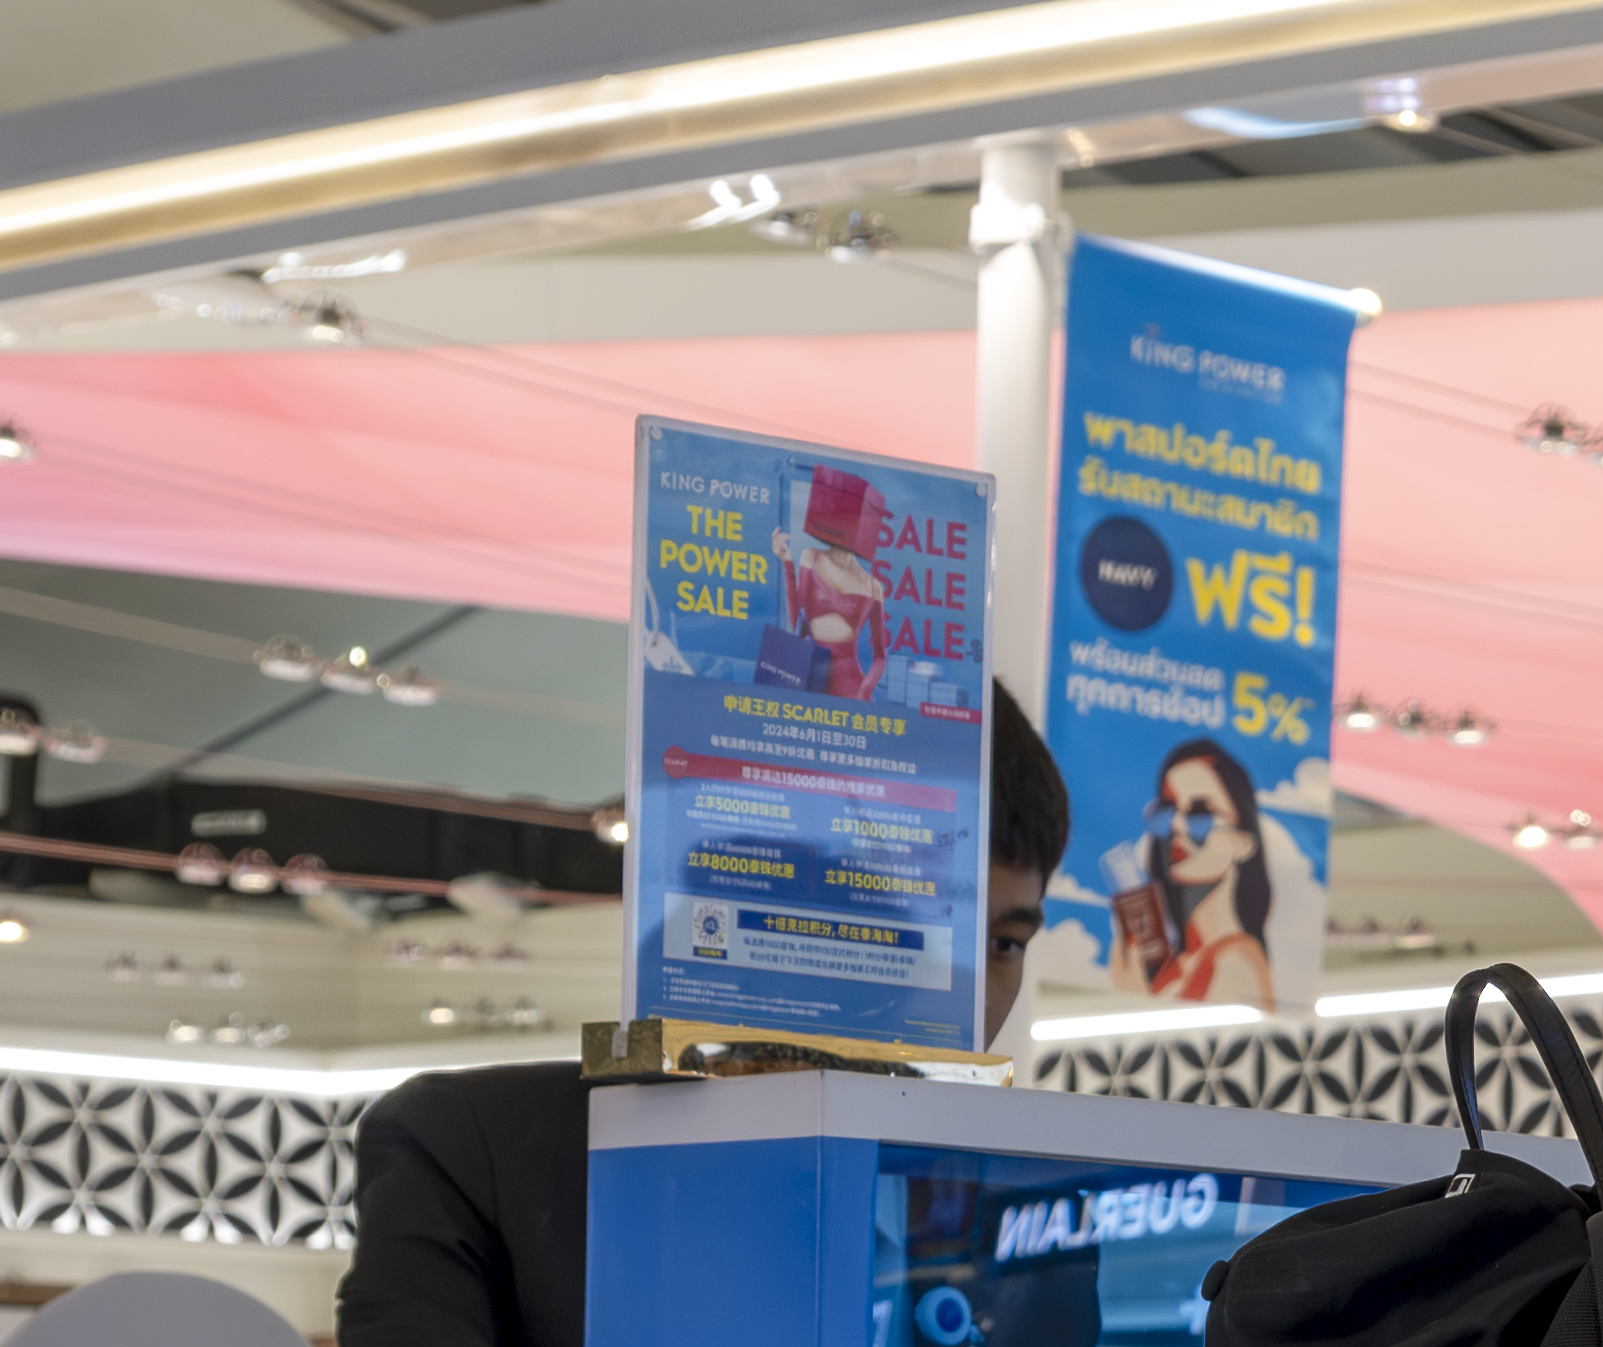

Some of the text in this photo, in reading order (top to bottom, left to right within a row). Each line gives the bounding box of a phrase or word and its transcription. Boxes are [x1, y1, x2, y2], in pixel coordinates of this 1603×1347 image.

[1130, 335, 1287, 392] KING POWER
[660, 472, 771, 504] KING POWER
[687, 505, 743, 541] THE
[878, 507, 968, 561] SALE
[660, 539, 768, 584] POWER
[677, 580, 750, 620] SALE
[872, 559, 967, 611] SALE
[1187, 549, 1316, 648] ฟรี!
[782, 702, 850, 728] SCARLET
